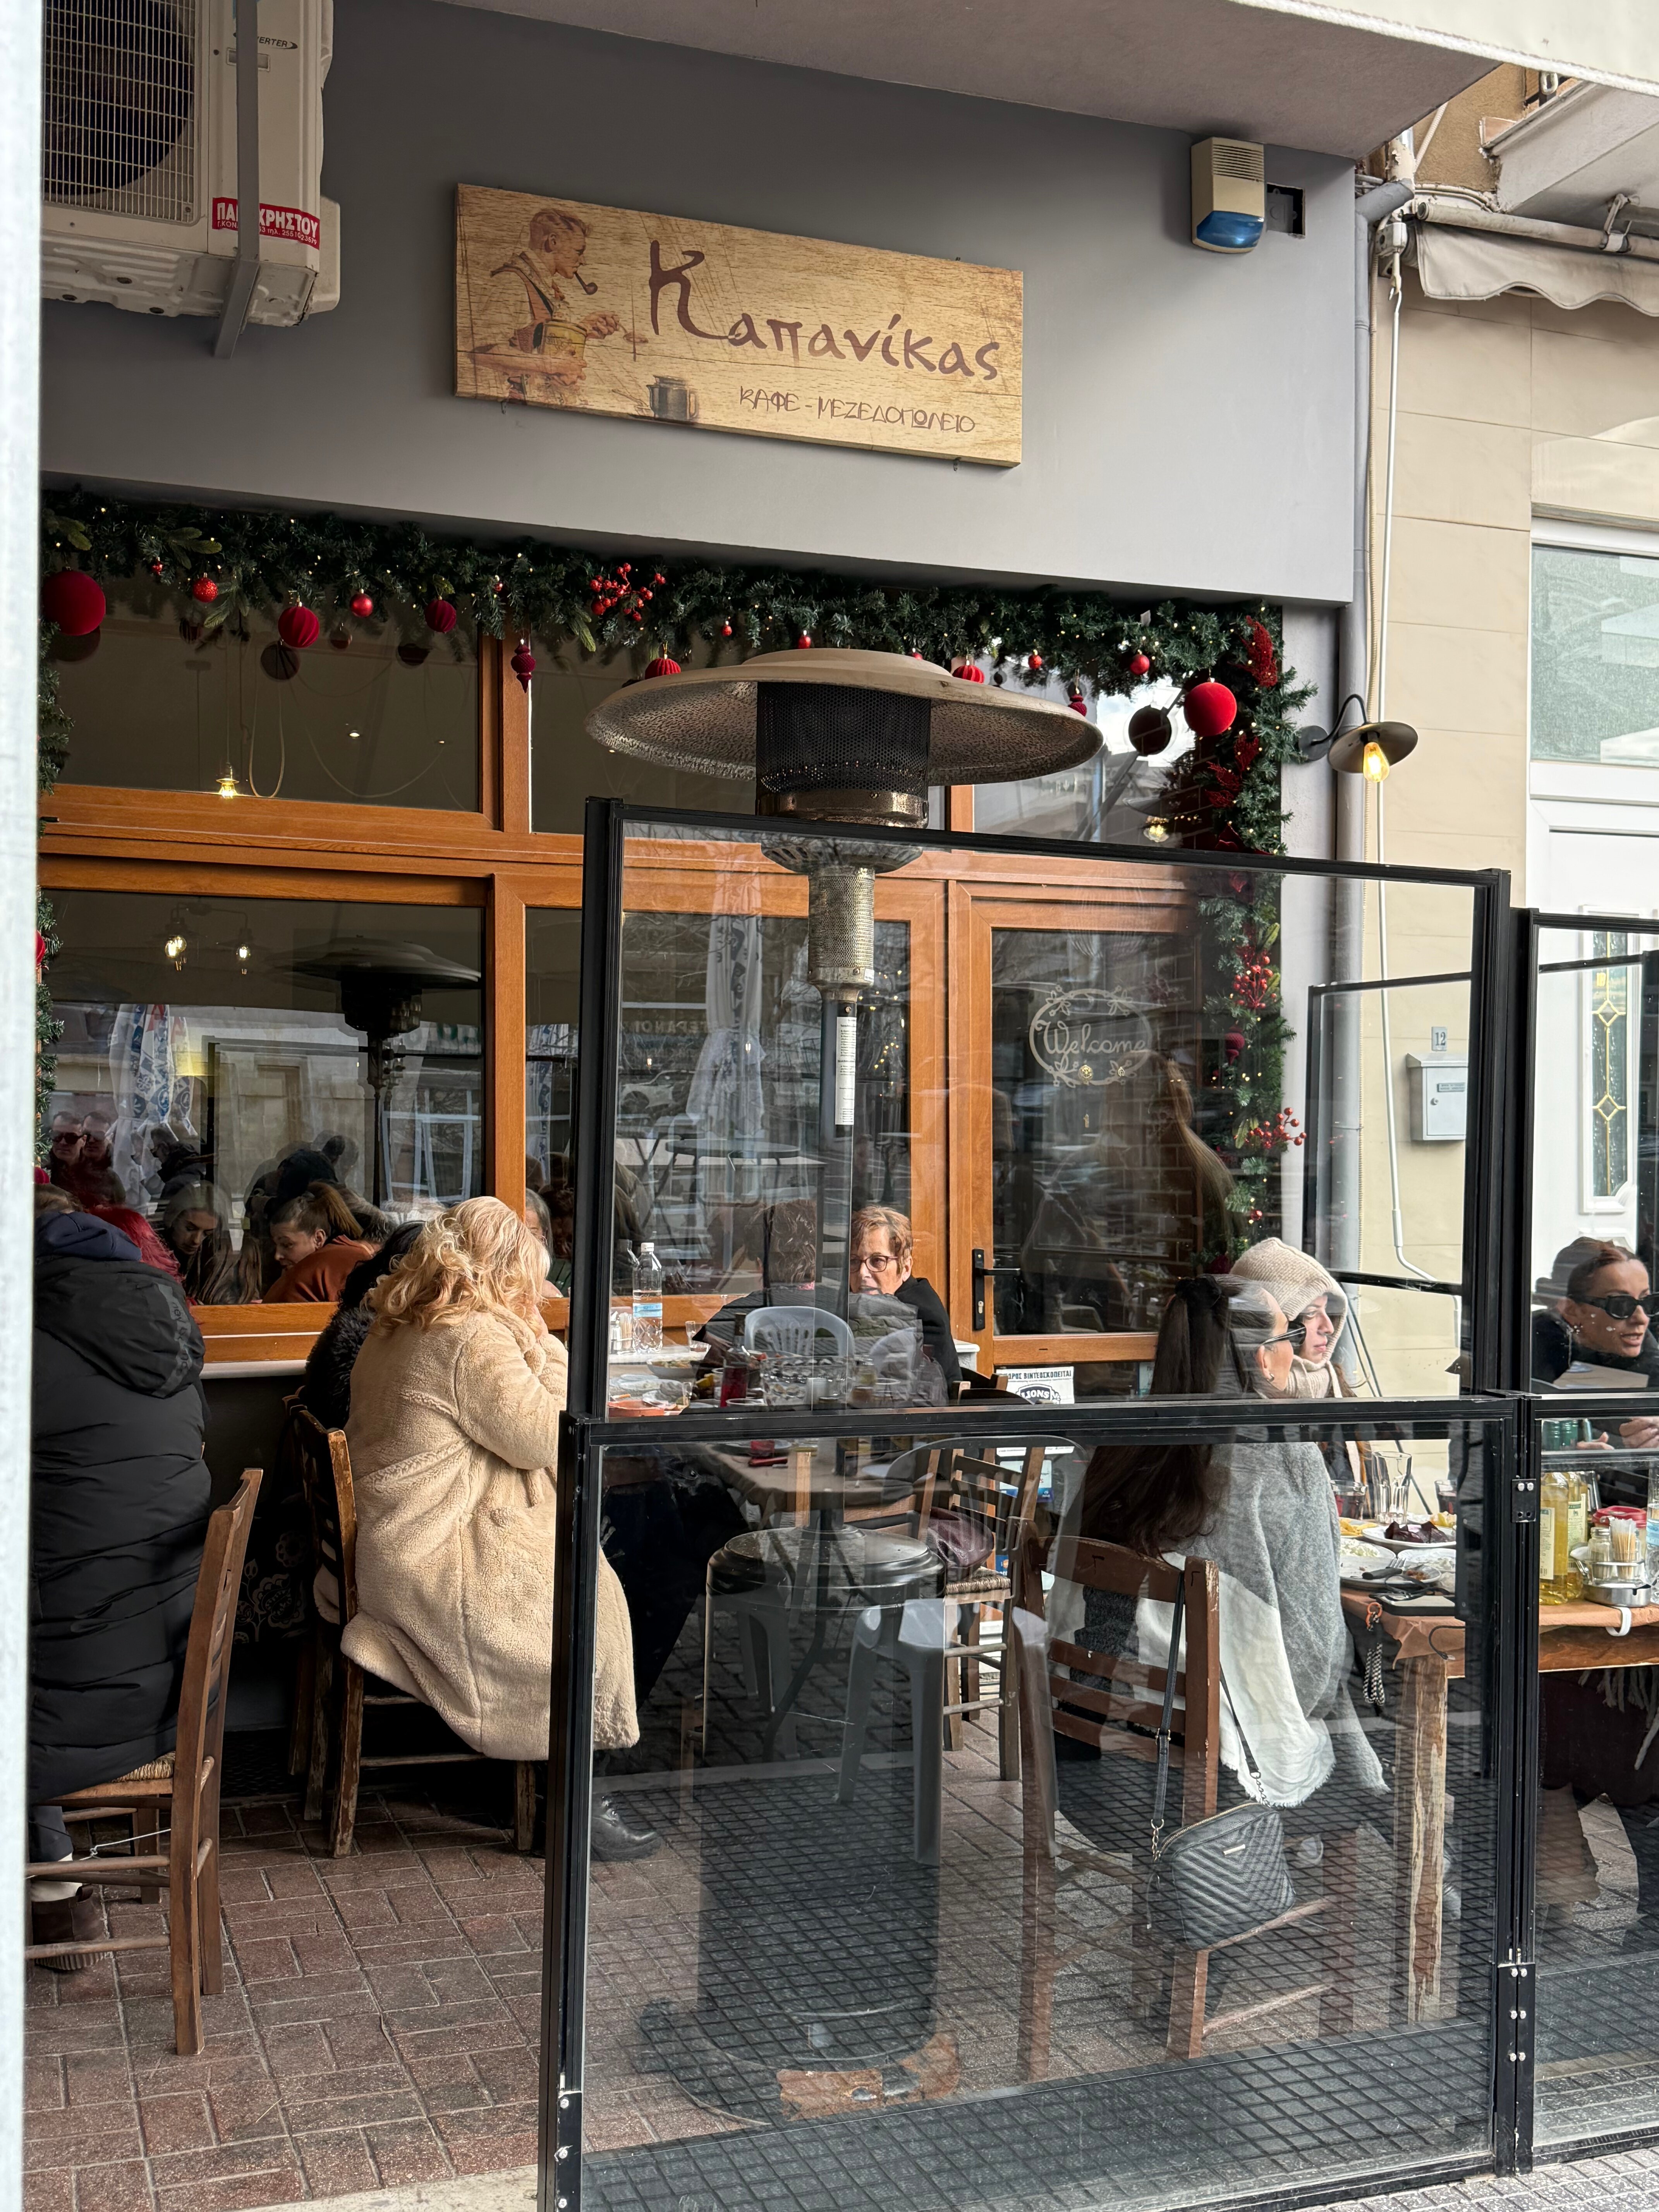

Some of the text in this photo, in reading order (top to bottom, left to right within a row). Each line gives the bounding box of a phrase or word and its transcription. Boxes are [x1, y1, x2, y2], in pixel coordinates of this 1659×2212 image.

[257, 36, 288, 47] ERTER
[217, 203, 318, 238] ΠΑΧΡΗΣΤΟΥ
[649, 240, 1000, 380] Καπανίκας
[740, 386, 800, 412] ΚΑΦΕ
[818, 396, 976, 433] ΜΕΖΕΔΟΠΩΛΕΙΟ
[1035, 1021, 1148, 1054] Welcome
[1435, 1032, 1446, 1046] 12
